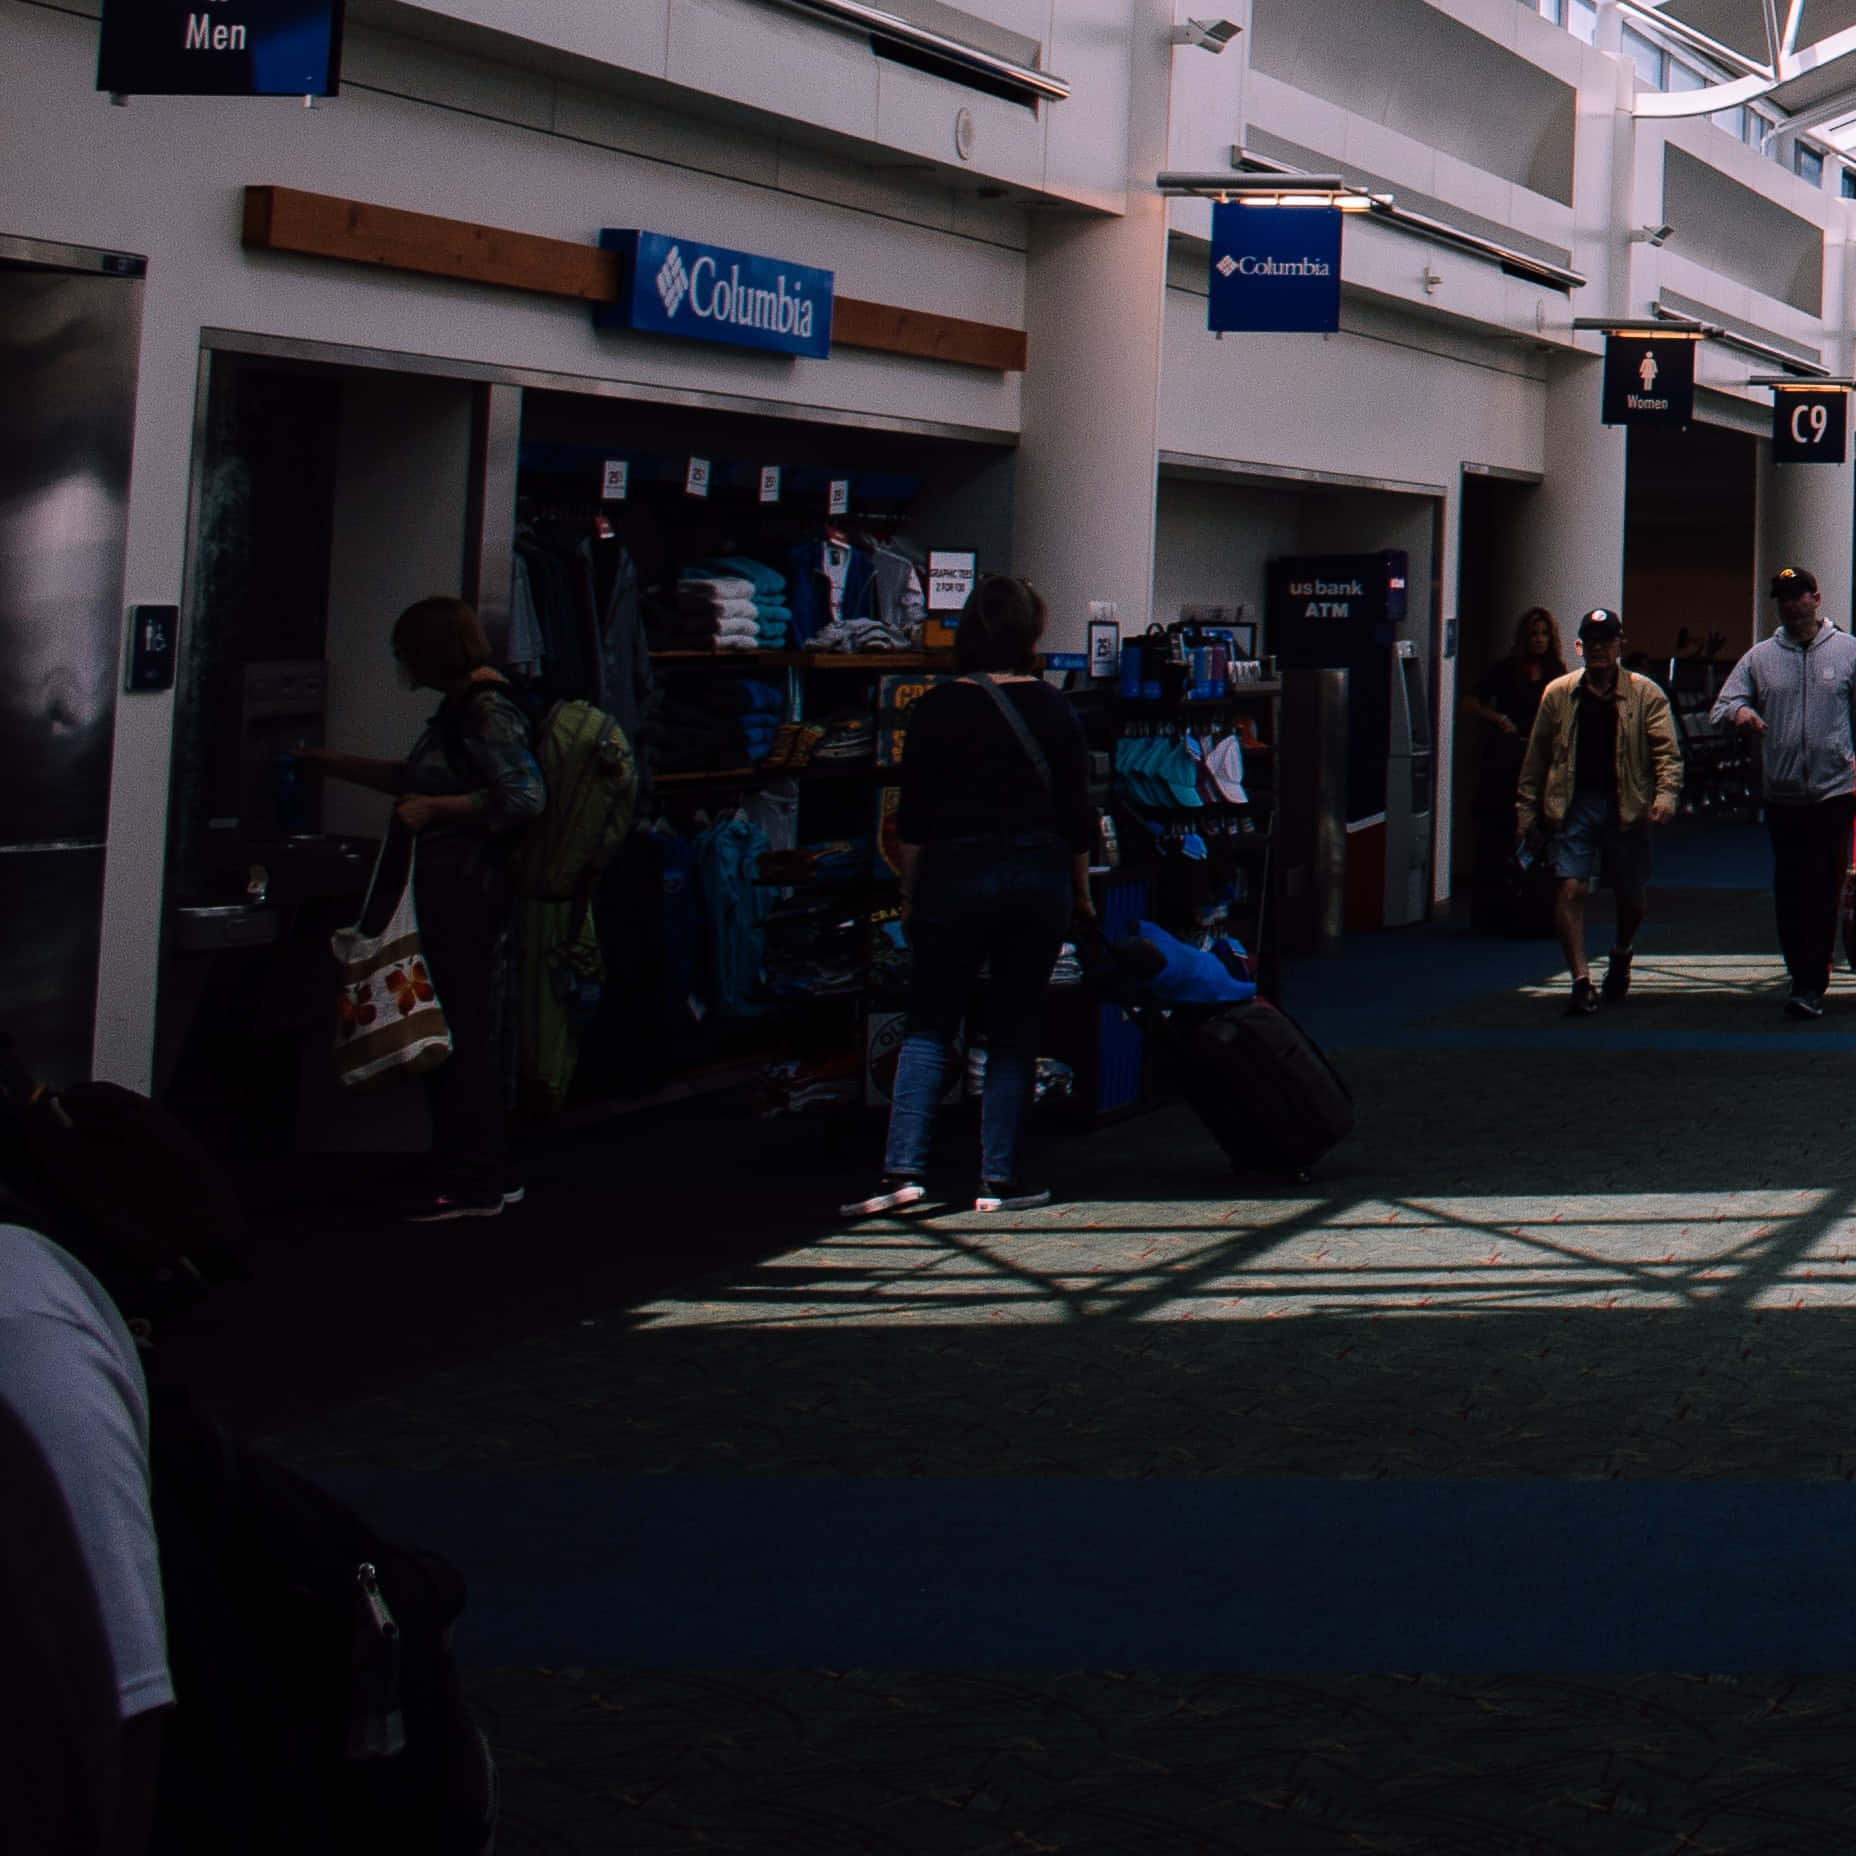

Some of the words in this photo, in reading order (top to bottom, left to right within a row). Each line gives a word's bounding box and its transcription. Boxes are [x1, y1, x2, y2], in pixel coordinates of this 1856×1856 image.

[185, 13, 247, 51] Men
[1239, 255, 1329, 276] Columbia
[689, 255, 813, 338] Columbia
[1627, 393, 1668, 410] Women
[1792, 404, 1827, 444] C9
[1304, 602, 1350, 619] ATM
